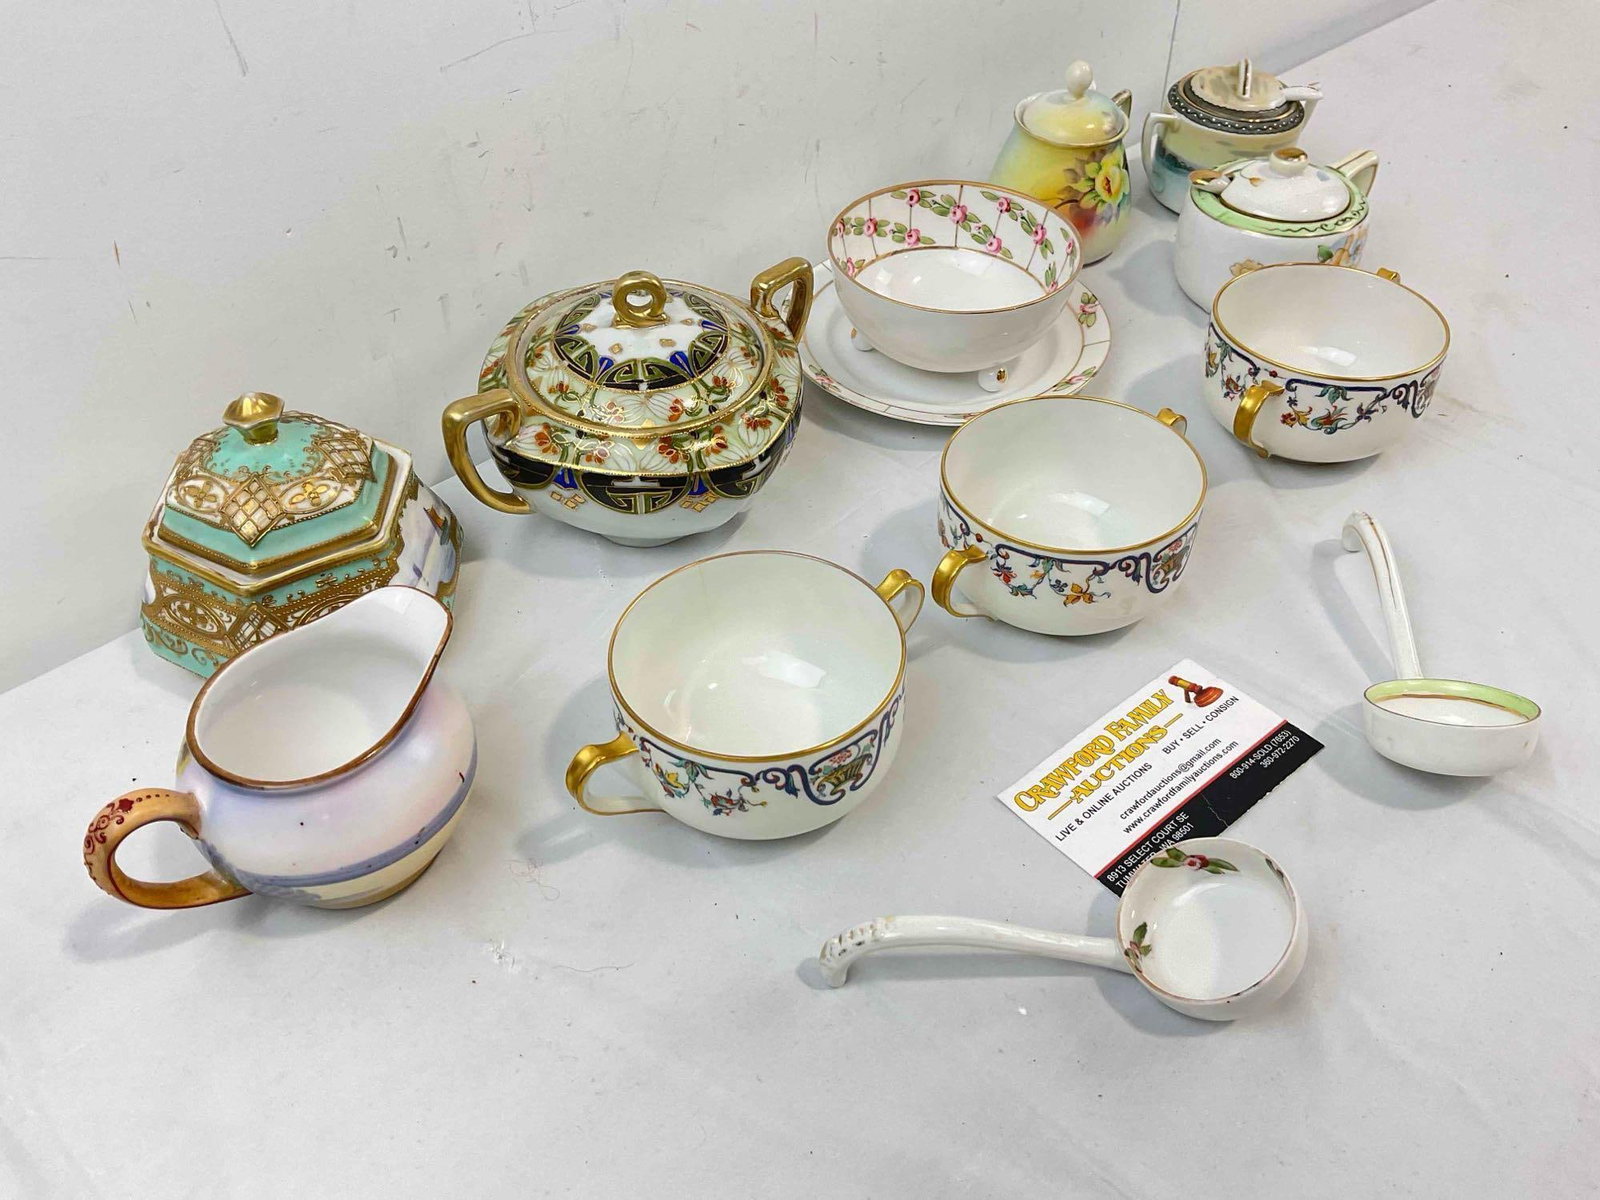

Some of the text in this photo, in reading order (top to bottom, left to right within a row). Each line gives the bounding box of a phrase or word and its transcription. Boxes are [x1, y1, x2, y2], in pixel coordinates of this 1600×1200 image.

[1014, 689, 1174, 812] CRAWFORD FAMILY
[1162, 695, 1239, 755] BUY SELL CONSIGN
[1229, 730, 1292, 779] 800-914-SOLD (7653)
[1259, 735, 1300, 769] 360-972-2270
[1056, 762, 1153, 841] LIVE & ONLINE AUCTIONS
[1070, 725, 1168, 804] AUCTIONS
[1120, 737, 1222, 820] crawfordauctions@gmail.com
[1123, 740, 1239, 834] www.crawfordfamilyauctions.com
[1106, 811, 1189, 882] 8913 SELECT COURT SE
[1171, 822, 1194, 841] 98501
